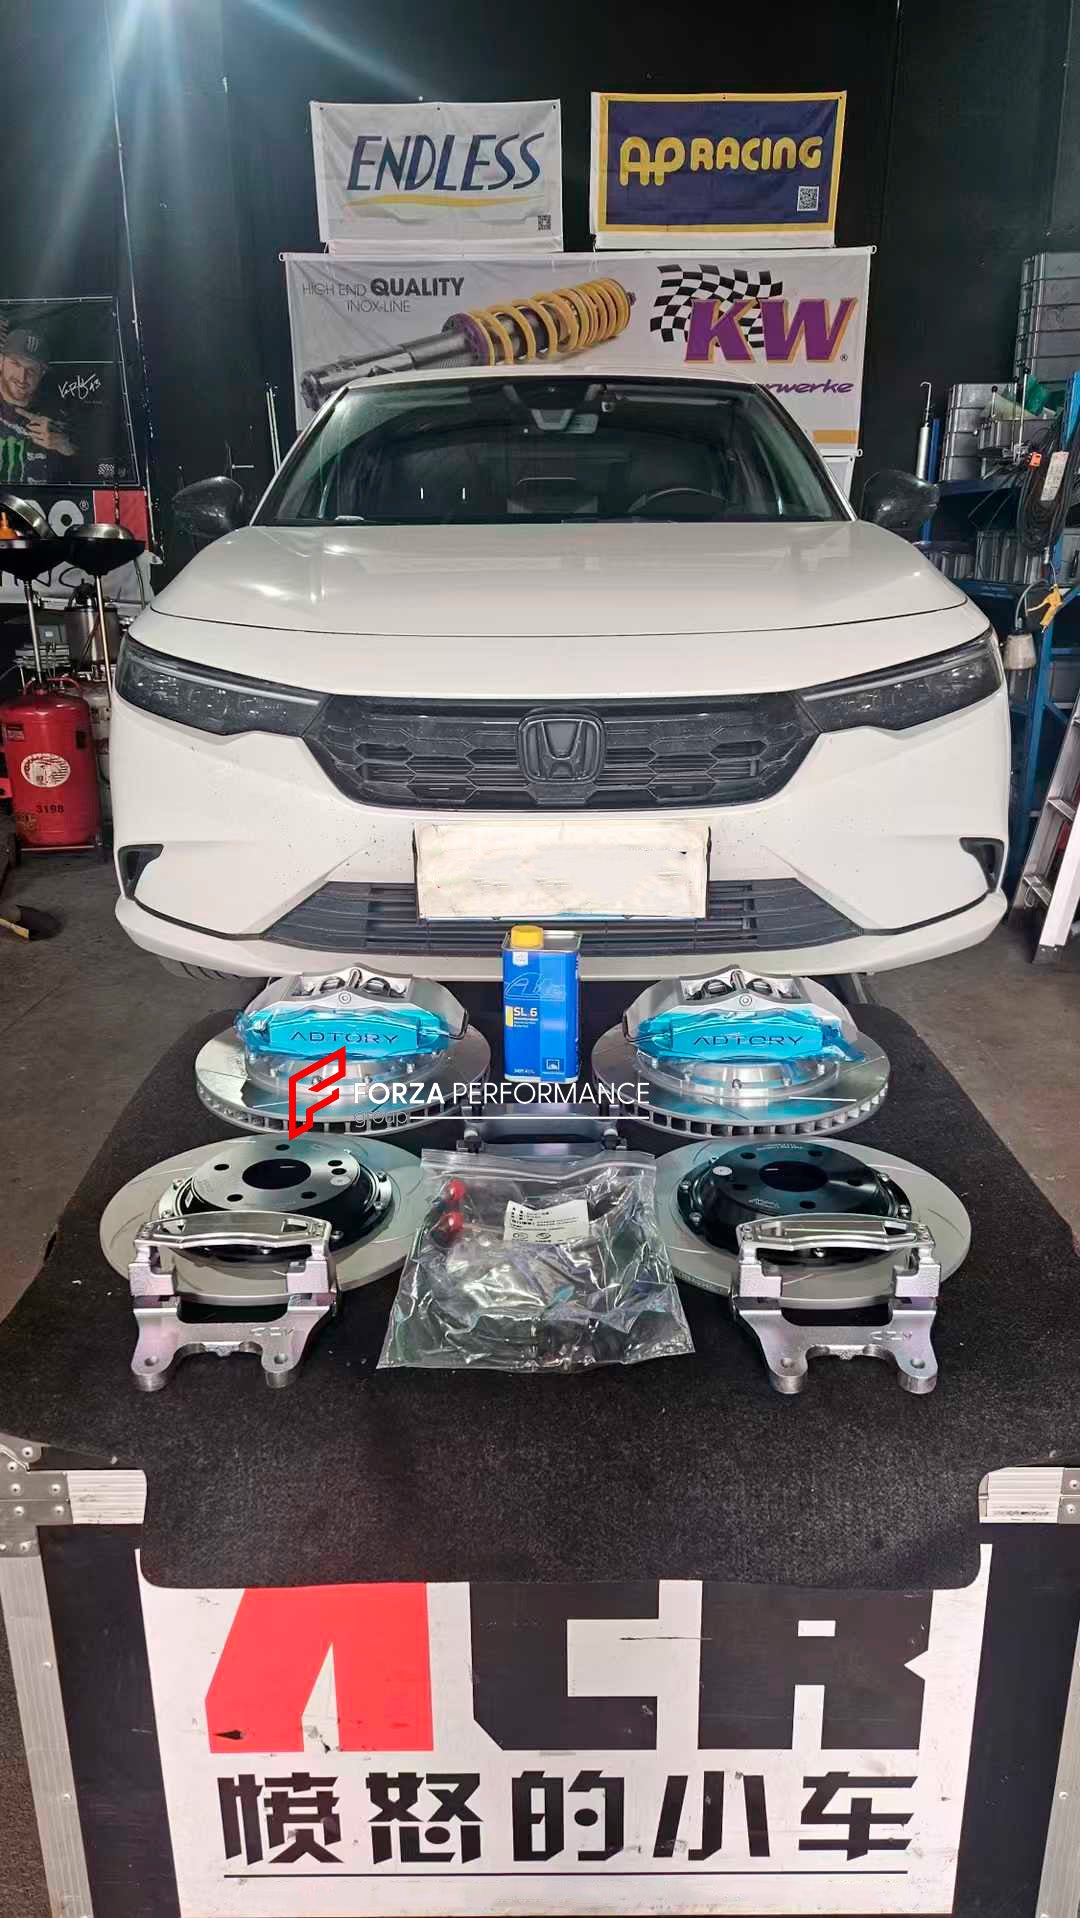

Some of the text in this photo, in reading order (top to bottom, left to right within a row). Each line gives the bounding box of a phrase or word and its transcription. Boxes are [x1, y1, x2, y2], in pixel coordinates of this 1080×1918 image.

[347, 132, 544, 191] ENDLESS
[619, 136, 823, 186] AP RACING
[302, 277, 464, 297] HIGH END QUALITY
[347, 300, 411, 313] INOX-LINE
[684, 297, 858, 364] KW
[36, 804, 65, 814] 3198
[290, 1031, 400, 1045] ADTORY
[217, 1771, 917, 1865] 愤怒的小车
